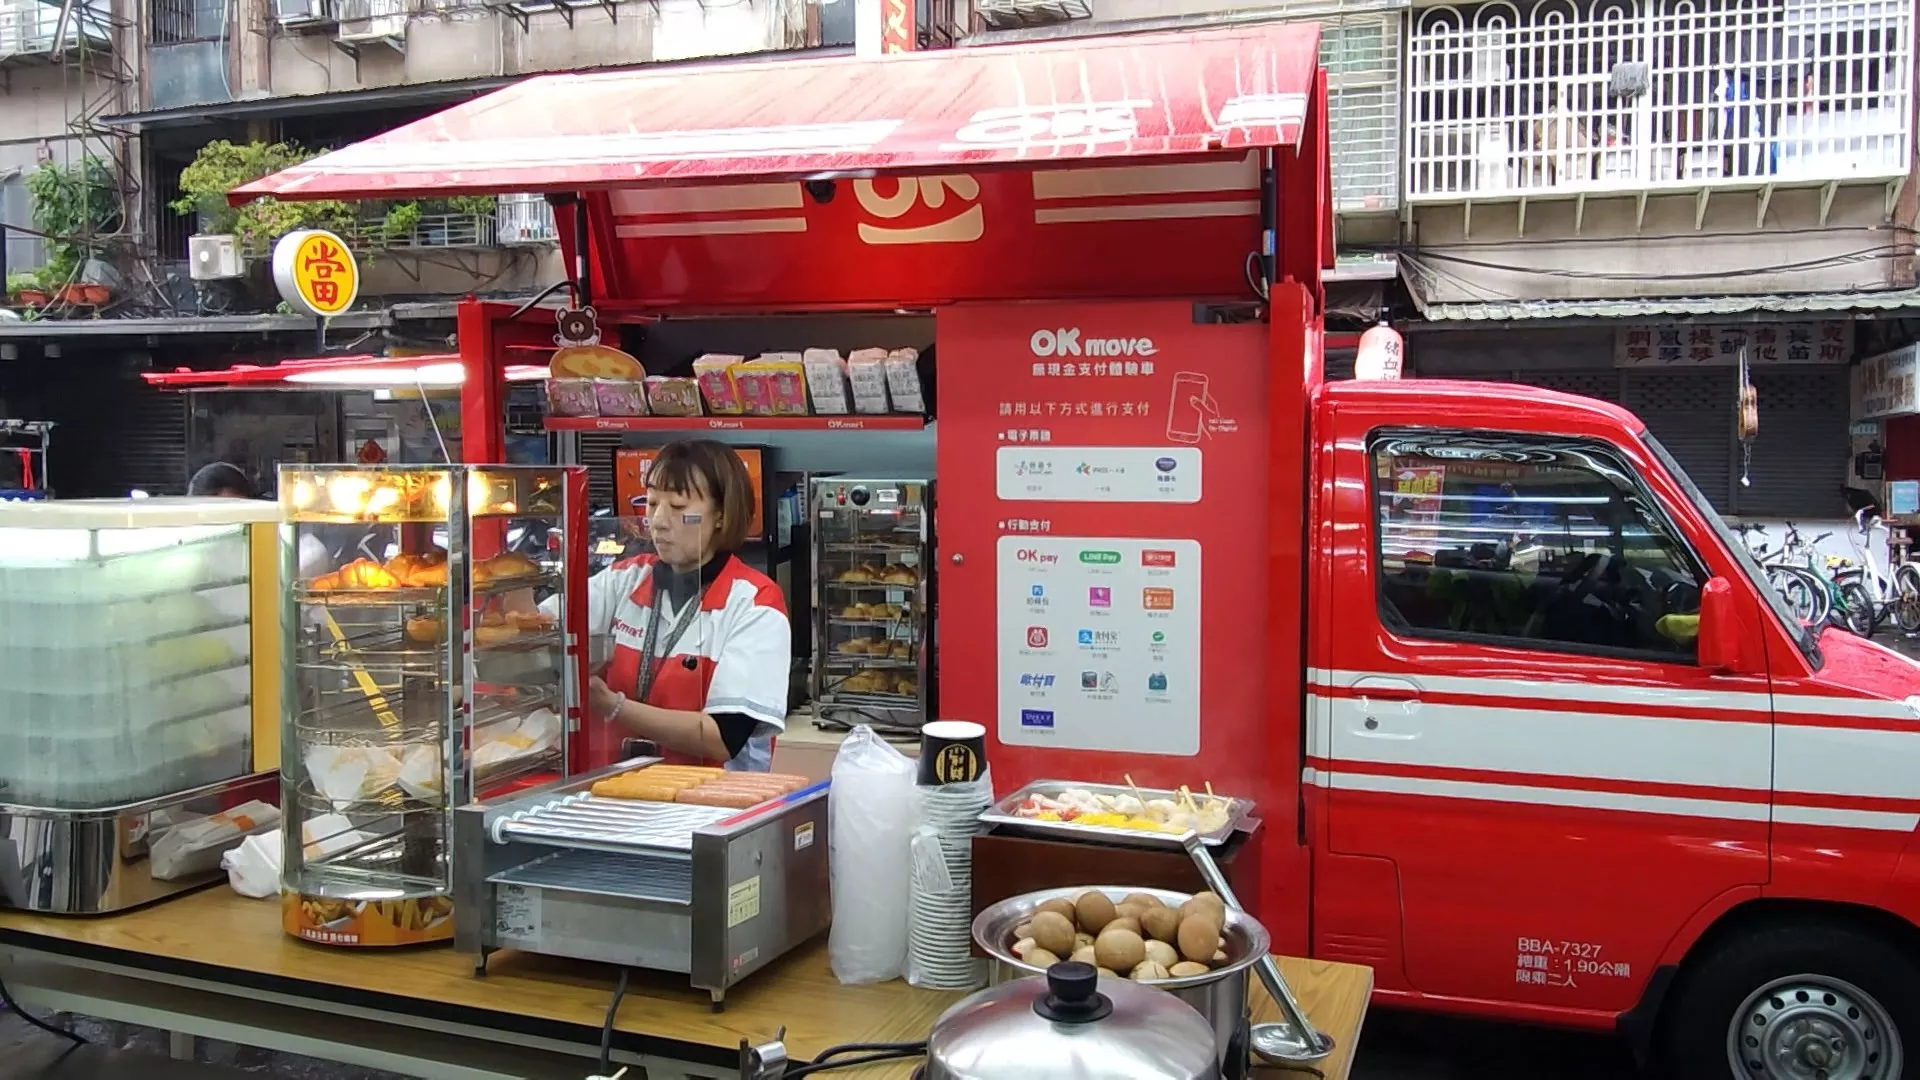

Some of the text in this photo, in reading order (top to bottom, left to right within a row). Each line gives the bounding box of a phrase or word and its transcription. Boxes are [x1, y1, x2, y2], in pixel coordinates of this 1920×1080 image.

[304, 241, 346, 306] 當
[1030, 327, 1160, 357] OK move
[1032, 361, 1154, 377] 無現金支付體驗車
[1000, 402, 1151, 418] 請用以下方式進行支付
[1007, 519, 1051, 531] 行動支付
[1017, 549, 1058, 566] OK pay
[1083, 552, 1118, 563] LINE Pay
[611, 617, 645, 638] Kmart
[1518, 937, 1602, 958] BBA-7327
